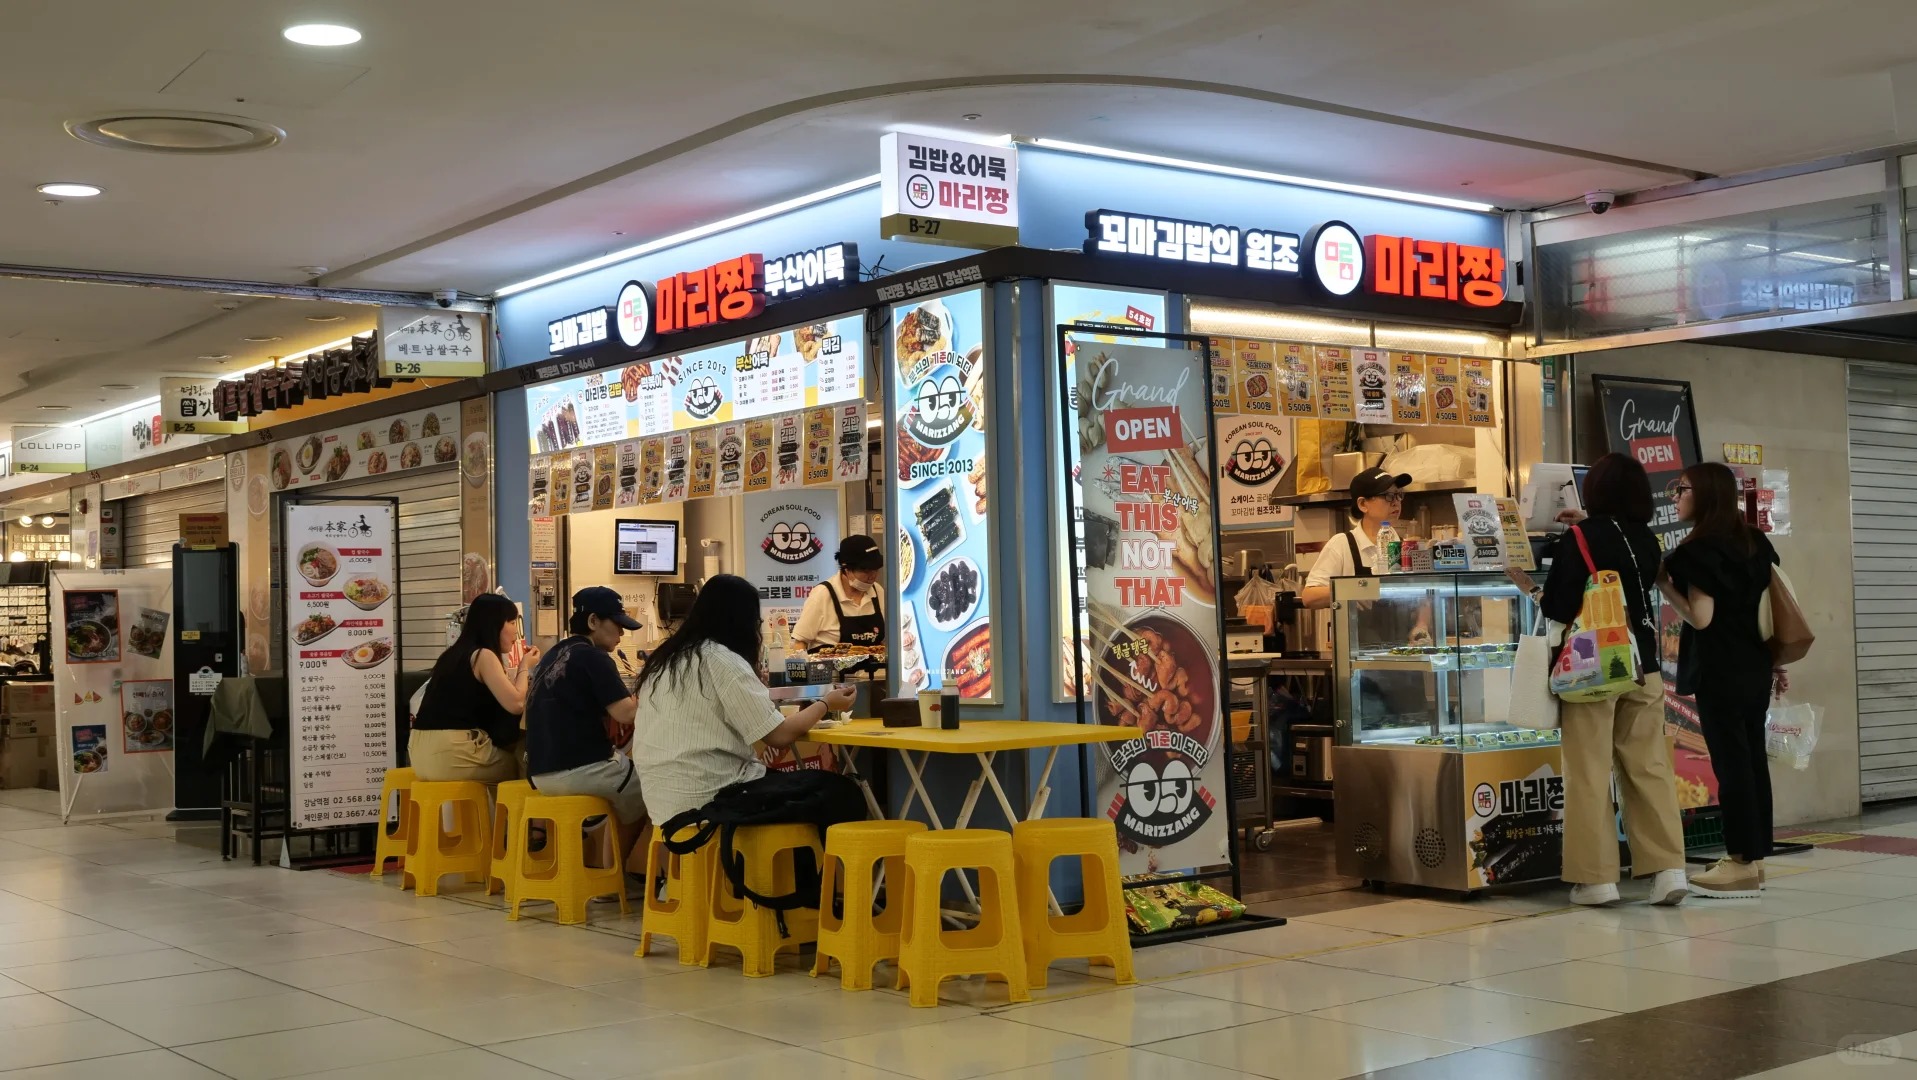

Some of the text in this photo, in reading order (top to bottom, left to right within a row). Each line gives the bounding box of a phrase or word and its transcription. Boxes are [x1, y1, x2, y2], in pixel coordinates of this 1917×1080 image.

[908, 145, 1006, 181] 김밥&어묵
[939, 180, 1009, 214] 마리짱
[910, 218, 940, 235] B-27
[1098, 214, 1505, 307] 꼬마김밥의 원조 마리짱
[877, 283, 905, 301] 마리짱
[905, 275, 939, 295] 54호점
[548, 245, 845, 352] 꼬마김밥 마리짱 부산어묵
[416, 320, 443, 335] 本家
[1128, 309, 1152, 328] 54호점
[821, 335, 842, 355] 튀김
[395, 363, 421, 374] B-26
[560, 357, 596, 374] 1577-4641
[736, 350, 769, 372] 부산어묵
[932, 351, 955, 365] 기준이
[955, 354, 972, 378] 되다
[678, 359, 727, 384] SINCE 2013
[585, 381, 623, 401] 마리짱 김밥
[1092, 358, 1190, 414] Grand
[182, 400, 196, 416] 쌀
[174, 423, 195, 432] B-25
[842, 416, 859, 433] 김밥
[916, 415, 965, 439] MARIZZANG
[1115, 417, 1171, 441] OPEN
[1620, 398, 1681, 441] Grand
[780, 426, 797, 444] 김밥
[1225, 423, 1247, 444] KOREAN
[1265, 422, 1282, 437] FOOD
[20, 442, 81, 450] LOLLIPOP
[671, 445, 684, 459] 김밥
[1637, 444, 1673, 464] OPEN
[622, 452, 635, 467] 김밥
[911, 458, 974, 479] SINCE 2013
[1119, 464, 1171, 494] EAT
[1233, 465, 1276, 481] MARIZZANG
[1163, 488, 1200, 517] 부산어묵
[1231, 494, 1254, 504] 쇼케이스
[760, 504, 784, 523] KOREAN
[804, 506, 821, 521] FOOD
[1114, 501, 1179, 532] THIS
[1231, 505, 1281, 516] 꼬마김밥 원조맛집
[324, 520, 347, 532] 本家
[770, 546, 814, 560] MARIZZANG
[1121, 539, 1177, 570] NOT
[1443, 548, 1465, 558] 마리짱
[759, 586, 791, 599] 글로벌
[1114, 576, 1186, 607] THAT
[1112, 638, 1150, 660] 탱글 탱글
[299, 660, 327, 669] 9,000원
[1681, 705, 1692, 717] THE
[1111, 730, 1209, 772] 분식의 기준이 되다
[304, 796, 329, 808] 강남역점
[1123, 807, 1201, 838] MARIZZANG
